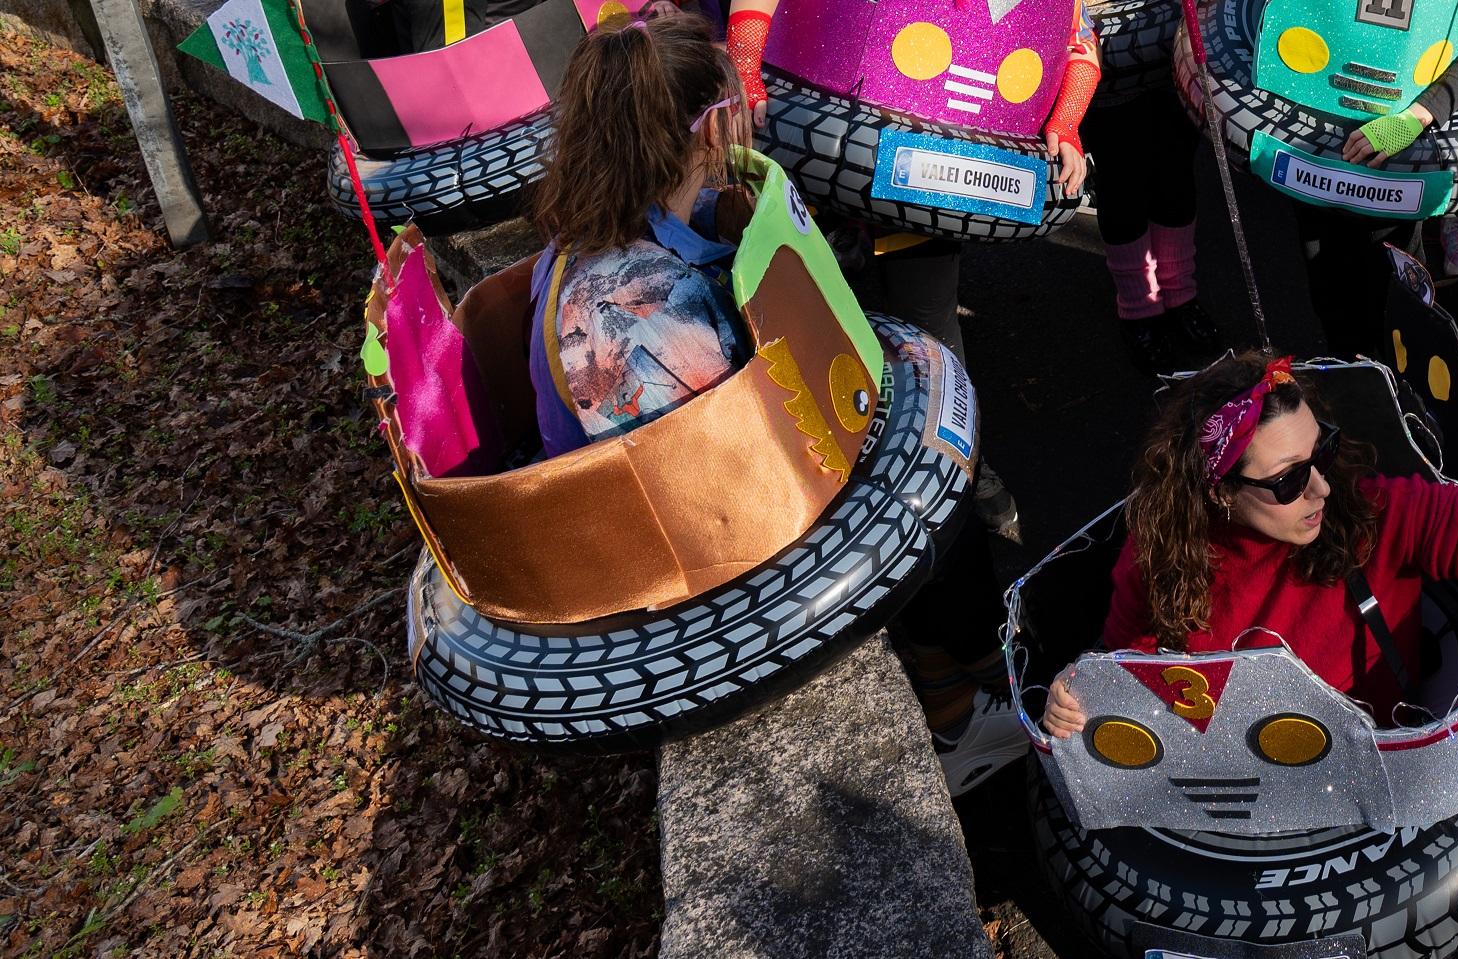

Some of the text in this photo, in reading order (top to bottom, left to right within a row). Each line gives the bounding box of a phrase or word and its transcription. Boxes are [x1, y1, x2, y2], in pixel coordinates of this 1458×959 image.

[921, 162, 960, 183] VALEI
[964, 169, 1021, 195] CHOQUES
[1295, 167, 1332, 191] VALEI
[1336, 174, 1404, 203] CHOQUES
[951, 396, 968, 430] VALEI
[1160, 665, 1216, 720] 3
